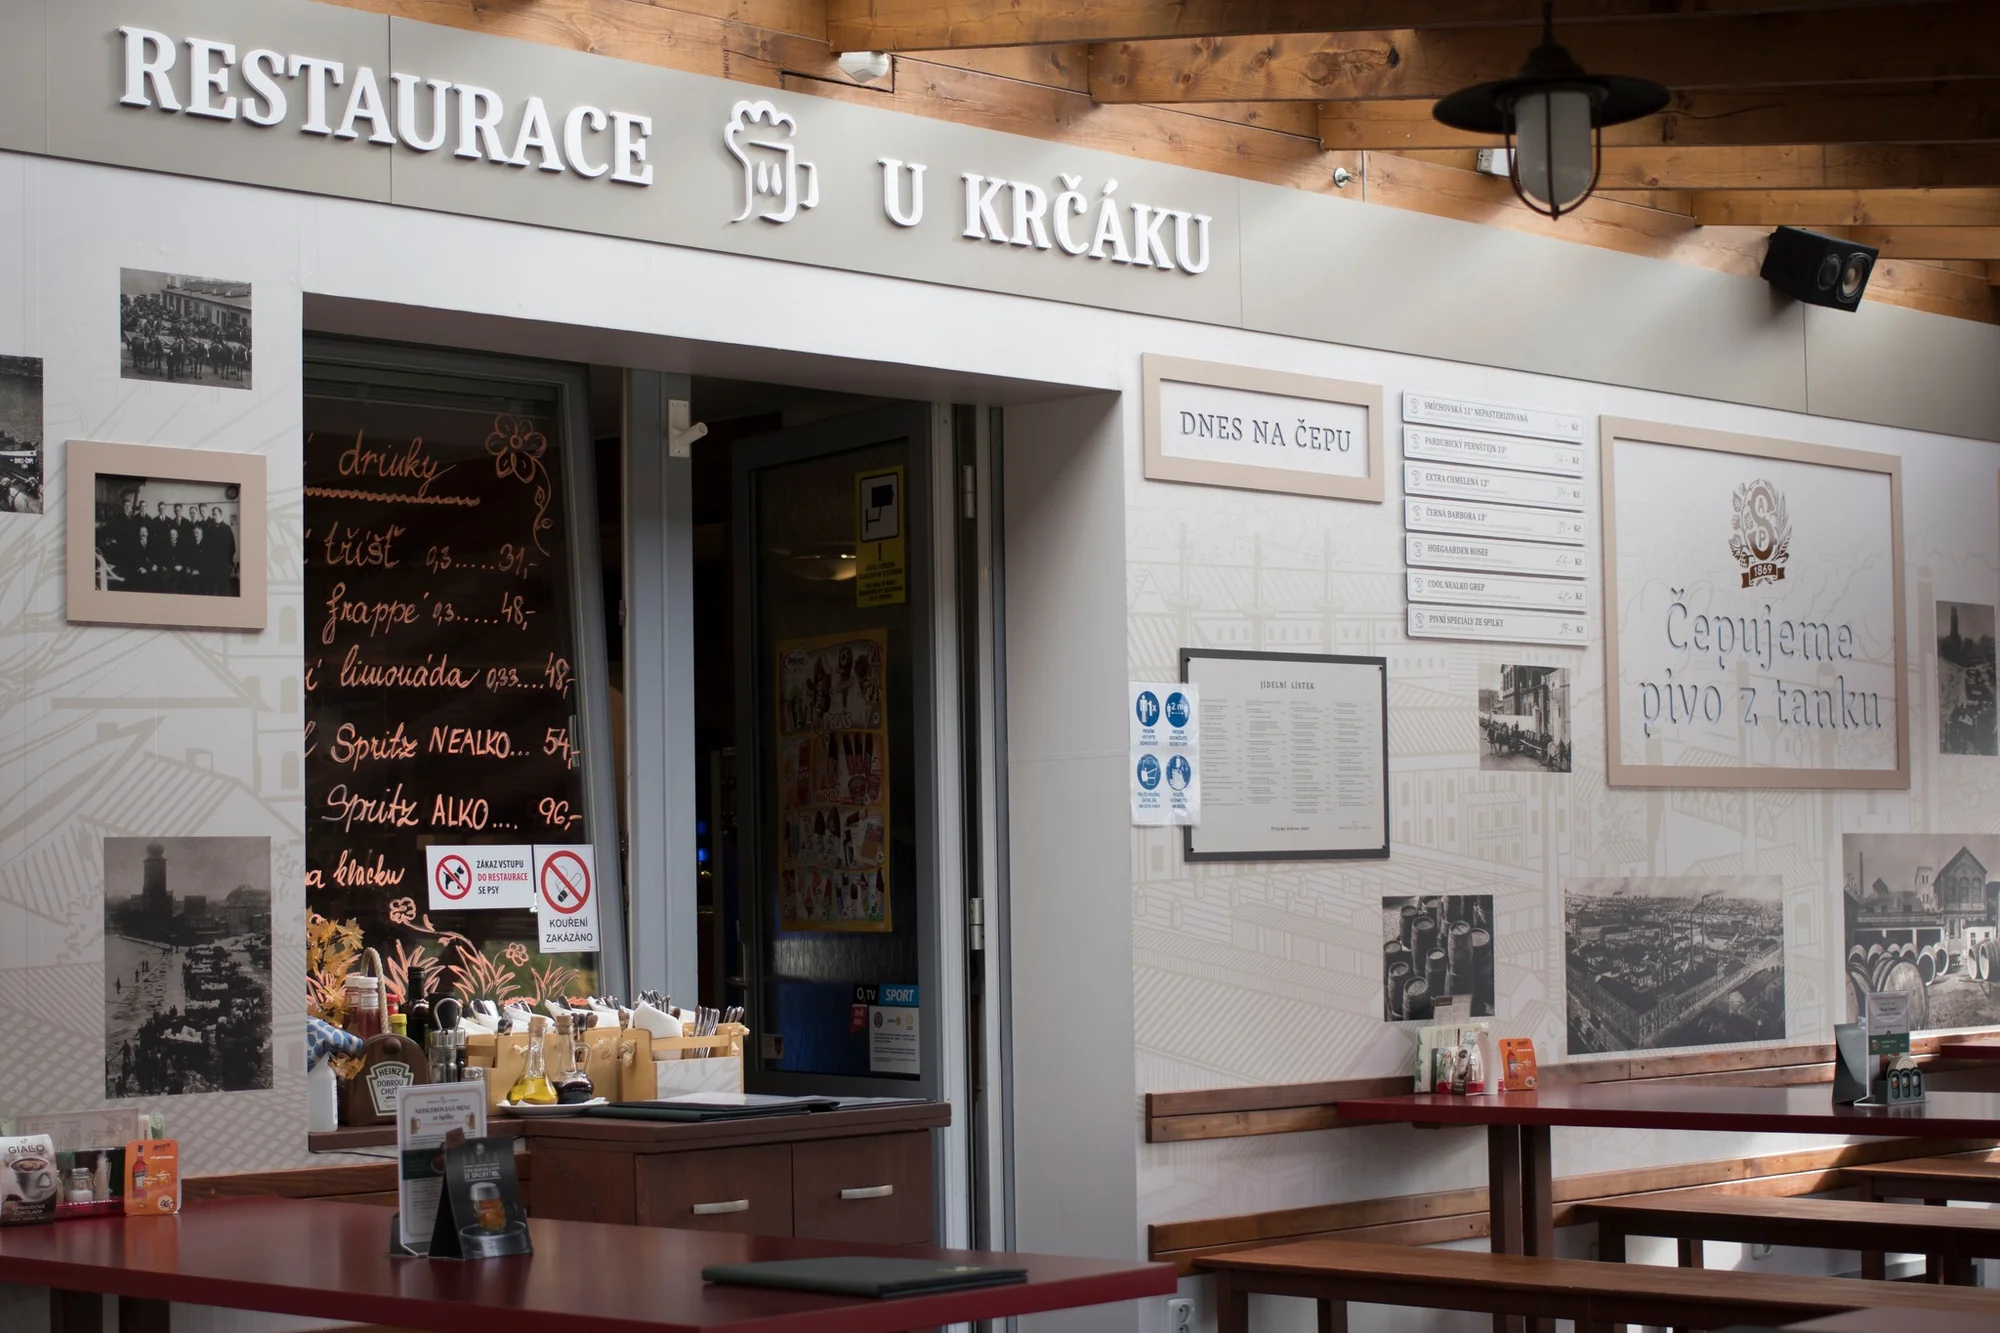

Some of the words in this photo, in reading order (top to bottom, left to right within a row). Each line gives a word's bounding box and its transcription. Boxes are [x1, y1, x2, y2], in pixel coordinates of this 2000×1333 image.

[118, 26, 654, 186] RESTAURACE
[877, 158, 927, 227] U
[960, 172, 1212, 275] KRČÁKU
[1424, 401, 1463, 414] SMÍCHOVSKÁ
[1474, 409, 1528, 423] NEPASTERIZOVANÁ
[1180, 411, 1243, 441] DNES
[1252, 419, 1286, 447] NA
[1295, 418, 1351, 452] ČEPU
[1571, 423, 1579, 431] Kč
[1424, 436, 1463, 449] PARDUBICKÝ
[1463, 440, 1497, 454] PERNŠTEJN
[1572, 456, 1580, 465] Kč
[1425, 473, 1446, 483] EXTRA
[1446, 475, 1479, 487] CHMELENÁ
[1572, 490, 1580, 499] Kč
[1426, 506, 1446, 517] ČERNÁ
[1447, 509, 1476, 520] BARBORA
[1574, 524, 1581, 532] Kč
[1427, 544, 1469, 555] HOEGAARDEN
[1575, 558, 1582, 566] Kč
[1753, 564, 1773, 576] 1869
[1427, 579, 1444, 589] COOL
[1444, 581, 1469, 591] NEALKO
[1469, 583, 1486, 591] GREP
[1575, 592, 1583, 600] Kč
[1429, 614, 1446, 624] PIVNÍ
[1446, 615, 1474, 626] SPECIÁLY
[1475, 617, 1483, 626] ZE
[1483, 618, 1504, 627] SPILKY
[1576, 626, 1584, 634] Kč
[1667, 587, 1853, 672] Čepujeme
[340, 644, 480, 688] limonáda
[1260, 680, 1287, 690] JÍDELNÍ
[1291, 681, 1315, 690] LÍSTEK
[1639, 668, 1723, 738] pivo
[1740, 687, 1758, 727] z
[1777, 675, 1882, 729] tanku
[331, 722, 417, 771] Spritz
[321, 783, 419, 832] Spritz
[476, 859, 498, 869] ZÁKAZ
[498, 860, 524, 869] VSTUPU
[477, 873, 487, 882] DO
[488, 872, 528, 882] RESTAURACE
[478, 886, 486, 895] SE
[487, 886, 500, 895] PSY
[549, 917, 588, 928] KOUŘENÍ
[546, 932, 593, 943] ZAKÁZÁNO
[866, 989, 876, 1000] TV
[885, 988, 915, 1002] SPORT
[378, 1067, 402, 1077] HEINZ
[377, 1079, 404, 1087] DOBROU
[8, 1144, 45, 1154] GIALLO
